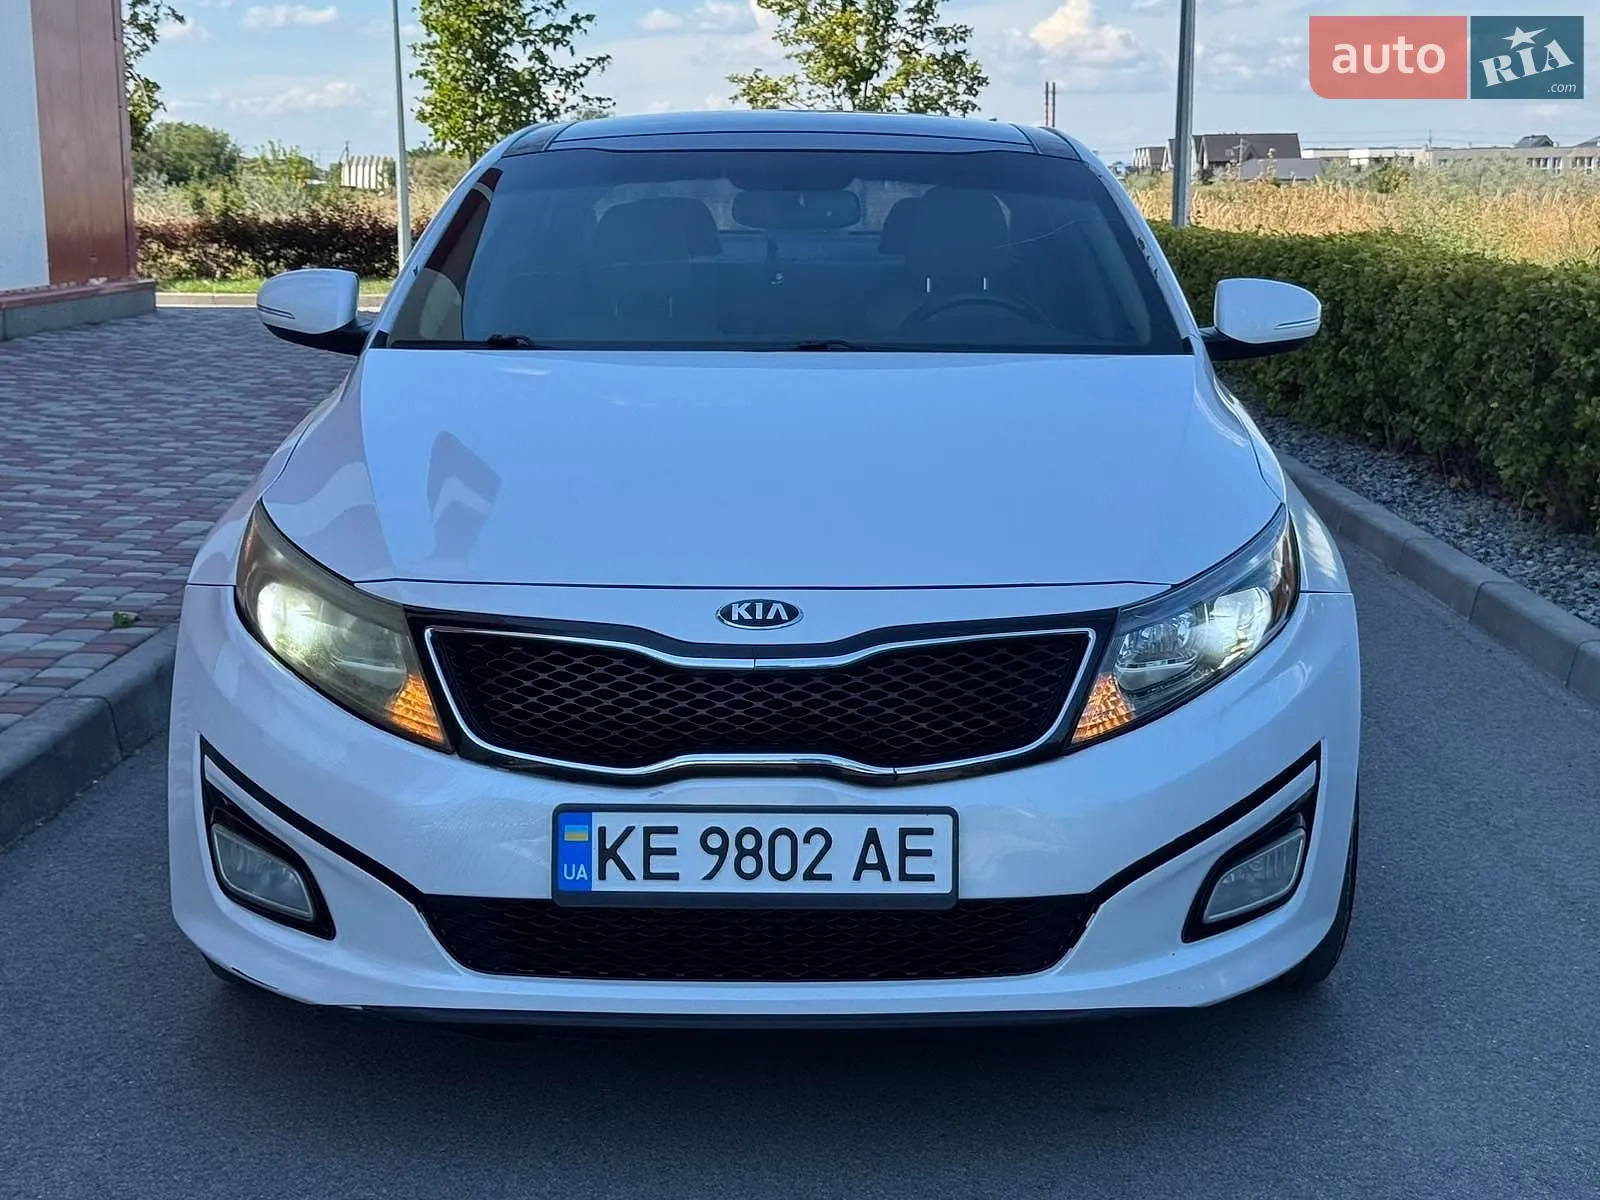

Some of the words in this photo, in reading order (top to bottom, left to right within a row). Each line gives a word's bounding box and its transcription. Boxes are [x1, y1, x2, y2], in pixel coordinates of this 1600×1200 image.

[731, 602, 789, 621] KIA
[597, 825, 680, 881] KE
[699, 825, 833, 882] 9802
[852, 827, 936, 882] AE
[563, 863, 588, 881] UA
